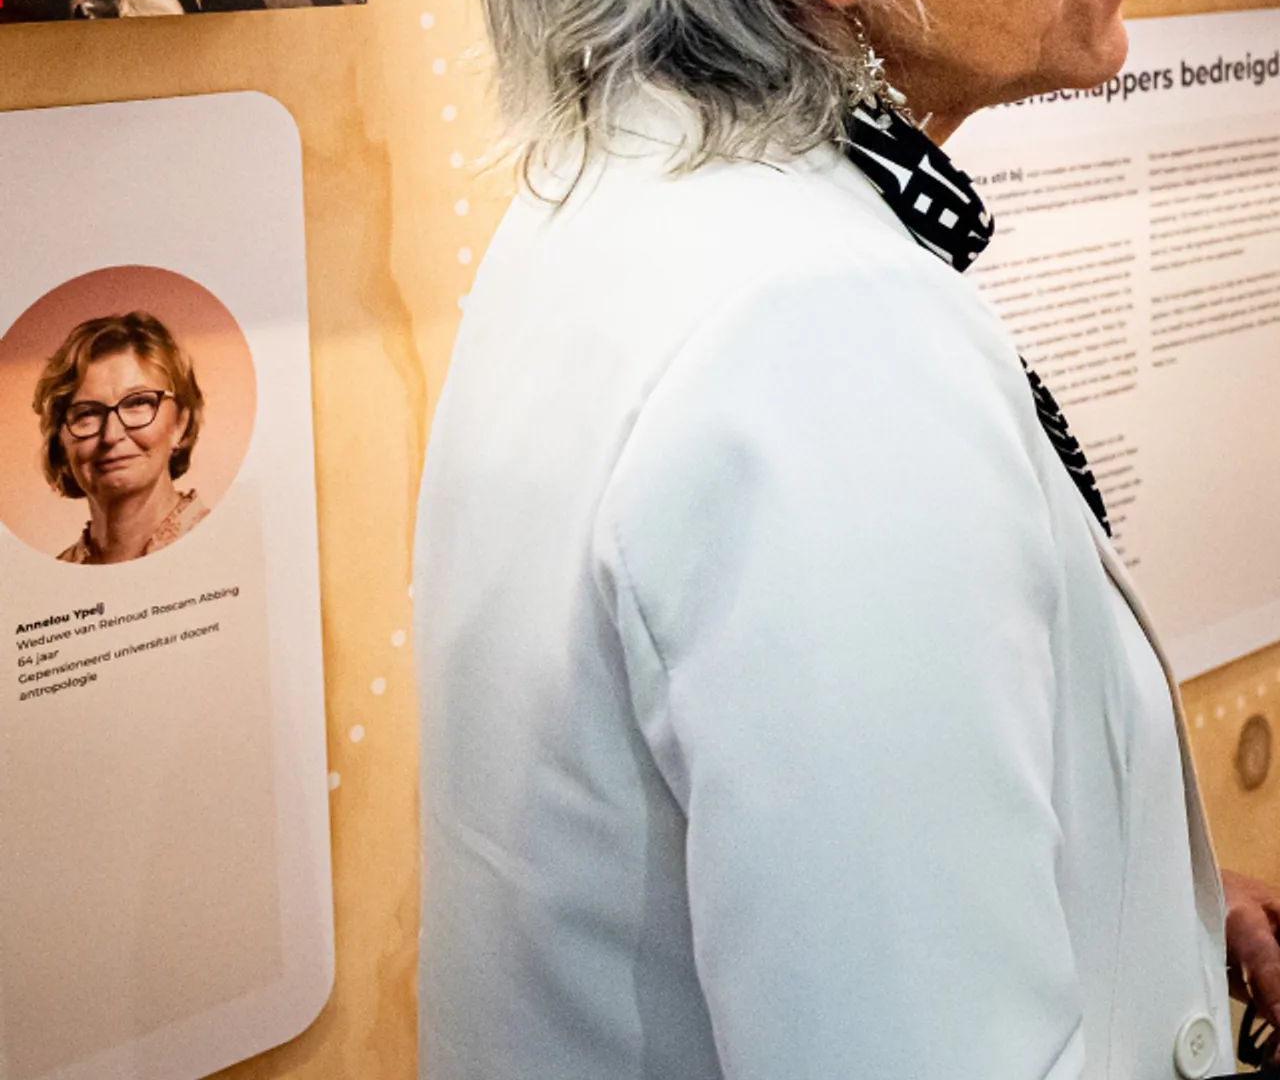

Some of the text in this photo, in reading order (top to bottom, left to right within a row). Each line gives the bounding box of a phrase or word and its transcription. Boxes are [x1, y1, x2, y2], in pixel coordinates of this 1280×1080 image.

[1181, 49, 1280, 87] bedreigd
[16, 586, 239, 651] Weduwe van Reinoud Roscam Abbing
[16, 614, 70, 635] Annelou
[18, 622, 220, 684] Gepensioneerd universitair docent
[18, 650, 59, 667] 64 jaar
[20, 672, 98, 701] antropologie
